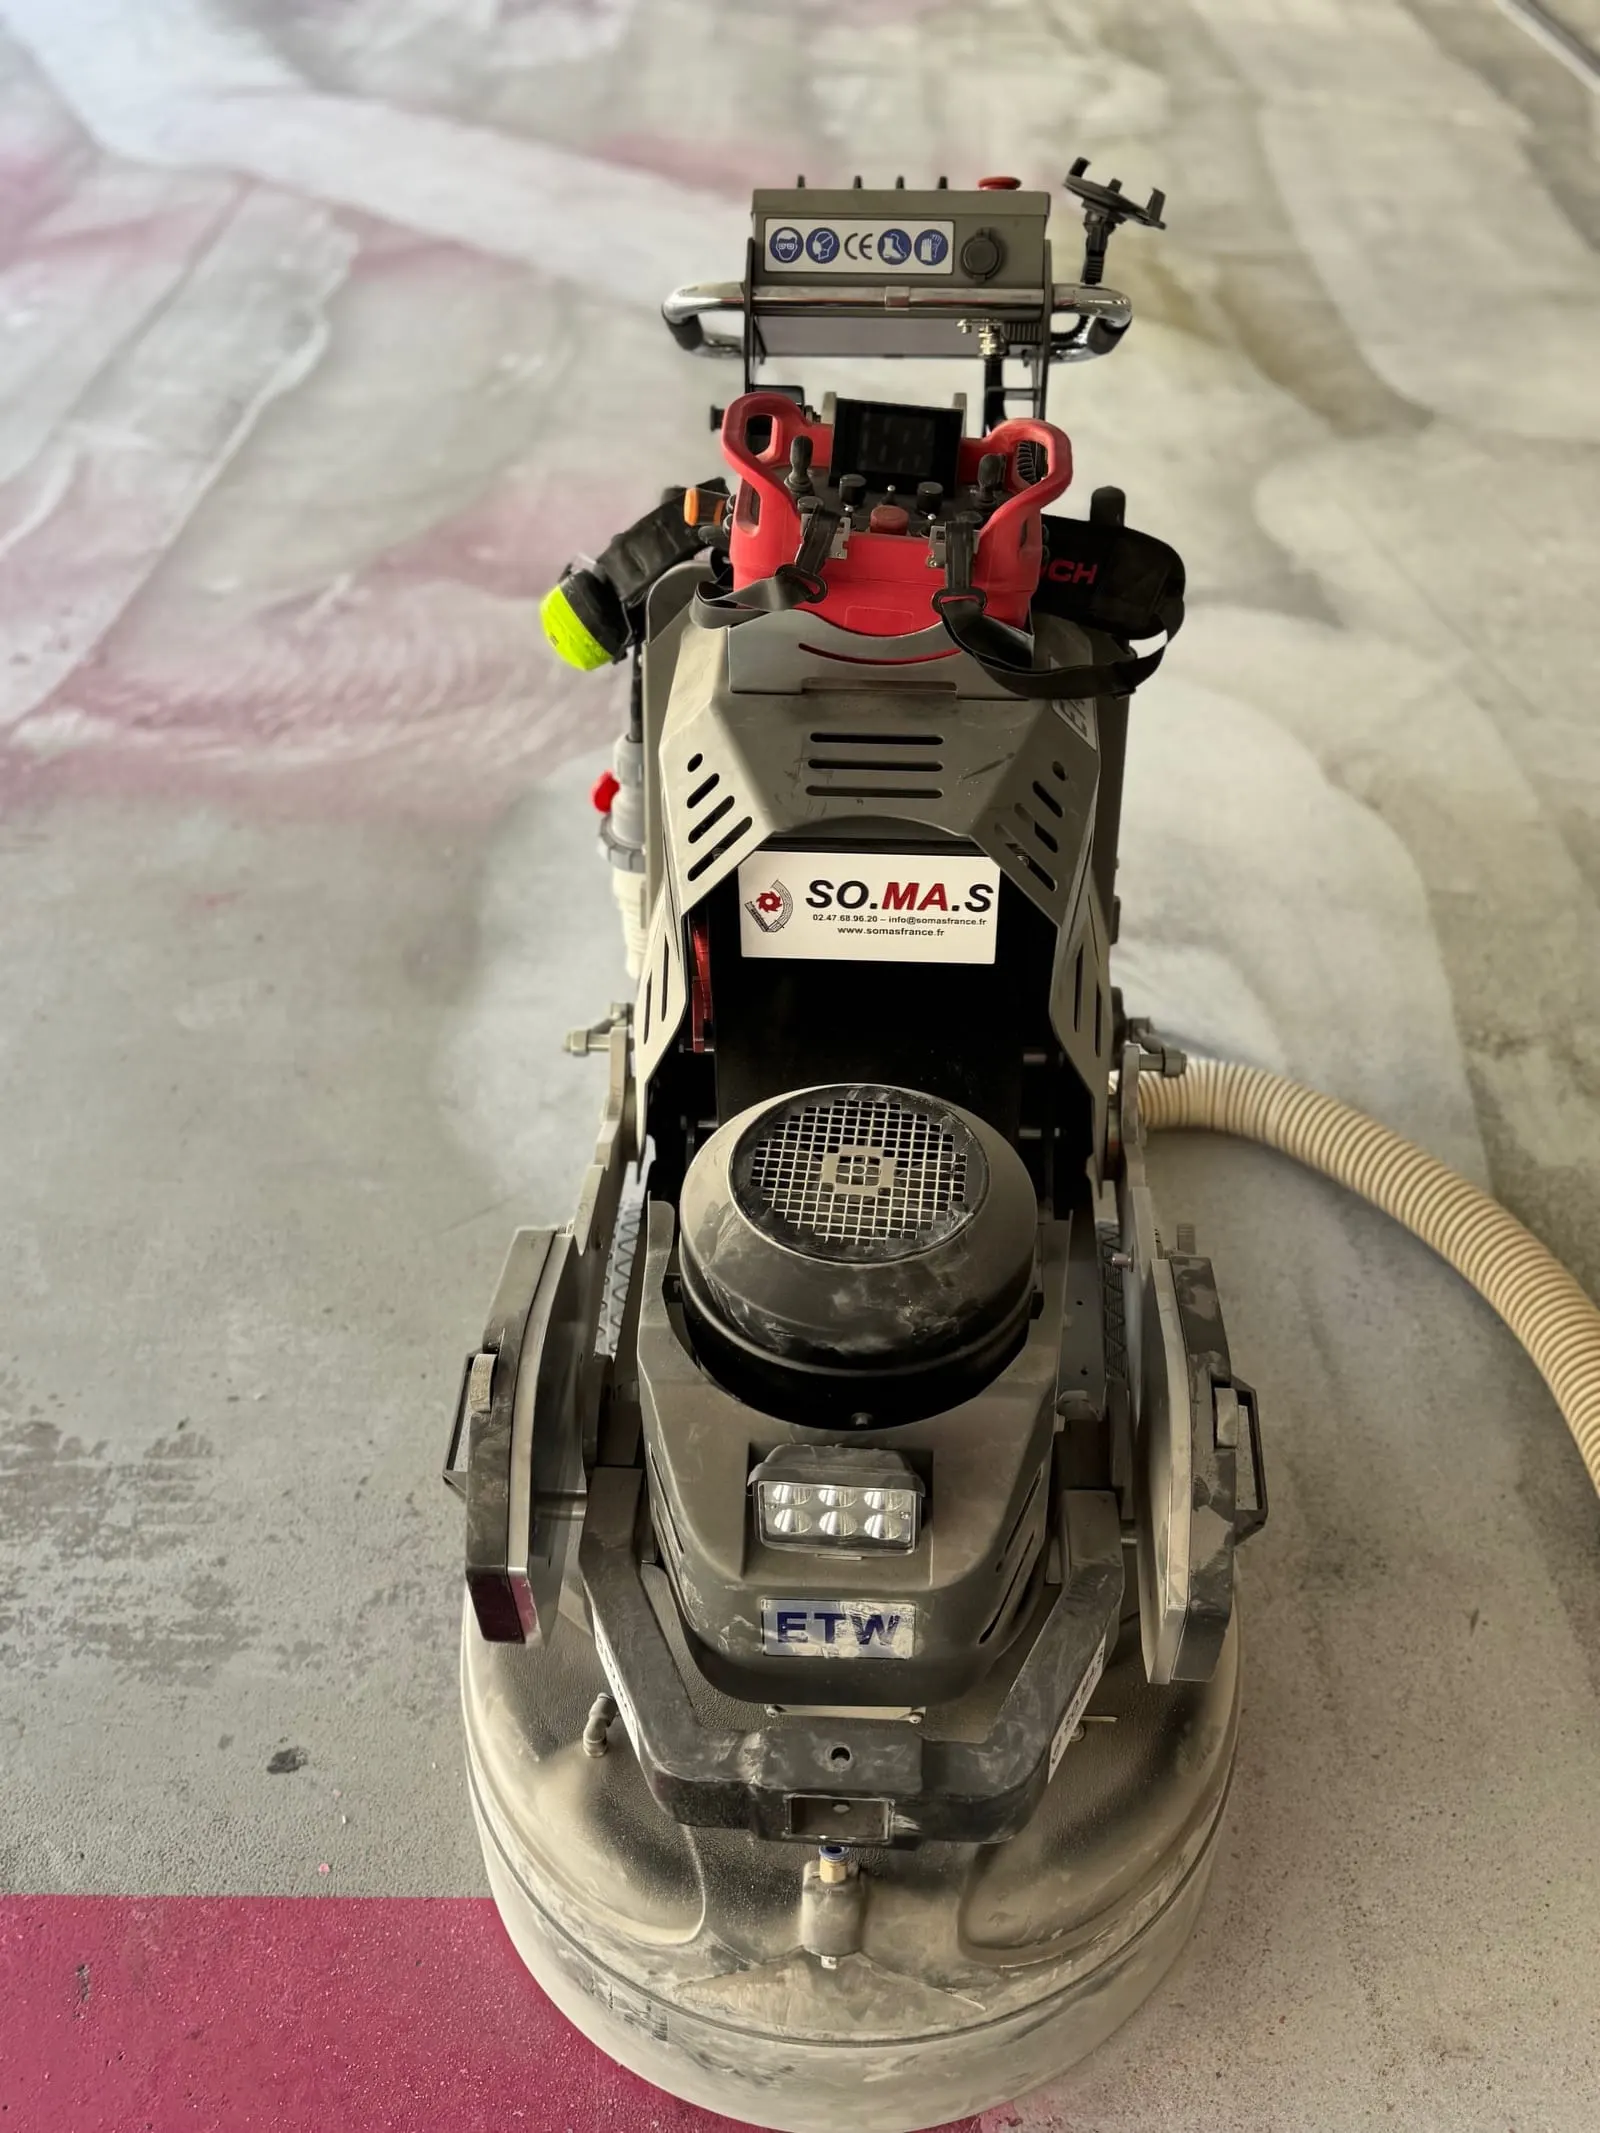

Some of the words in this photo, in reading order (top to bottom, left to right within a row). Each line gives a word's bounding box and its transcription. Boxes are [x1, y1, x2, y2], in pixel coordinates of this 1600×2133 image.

[844, 232, 873, 261] CE
[1040, 559, 1098, 585] CH
[805, 879, 994, 912] SO.MA.S
[812, 914, 878, 923] 02.47.68.96.20
[888, 916, 987, 926] info@somasfrance.fr
[837, 926, 945, 936] www.somasfrance.fr
[777, 1611, 900, 1646] ETW
